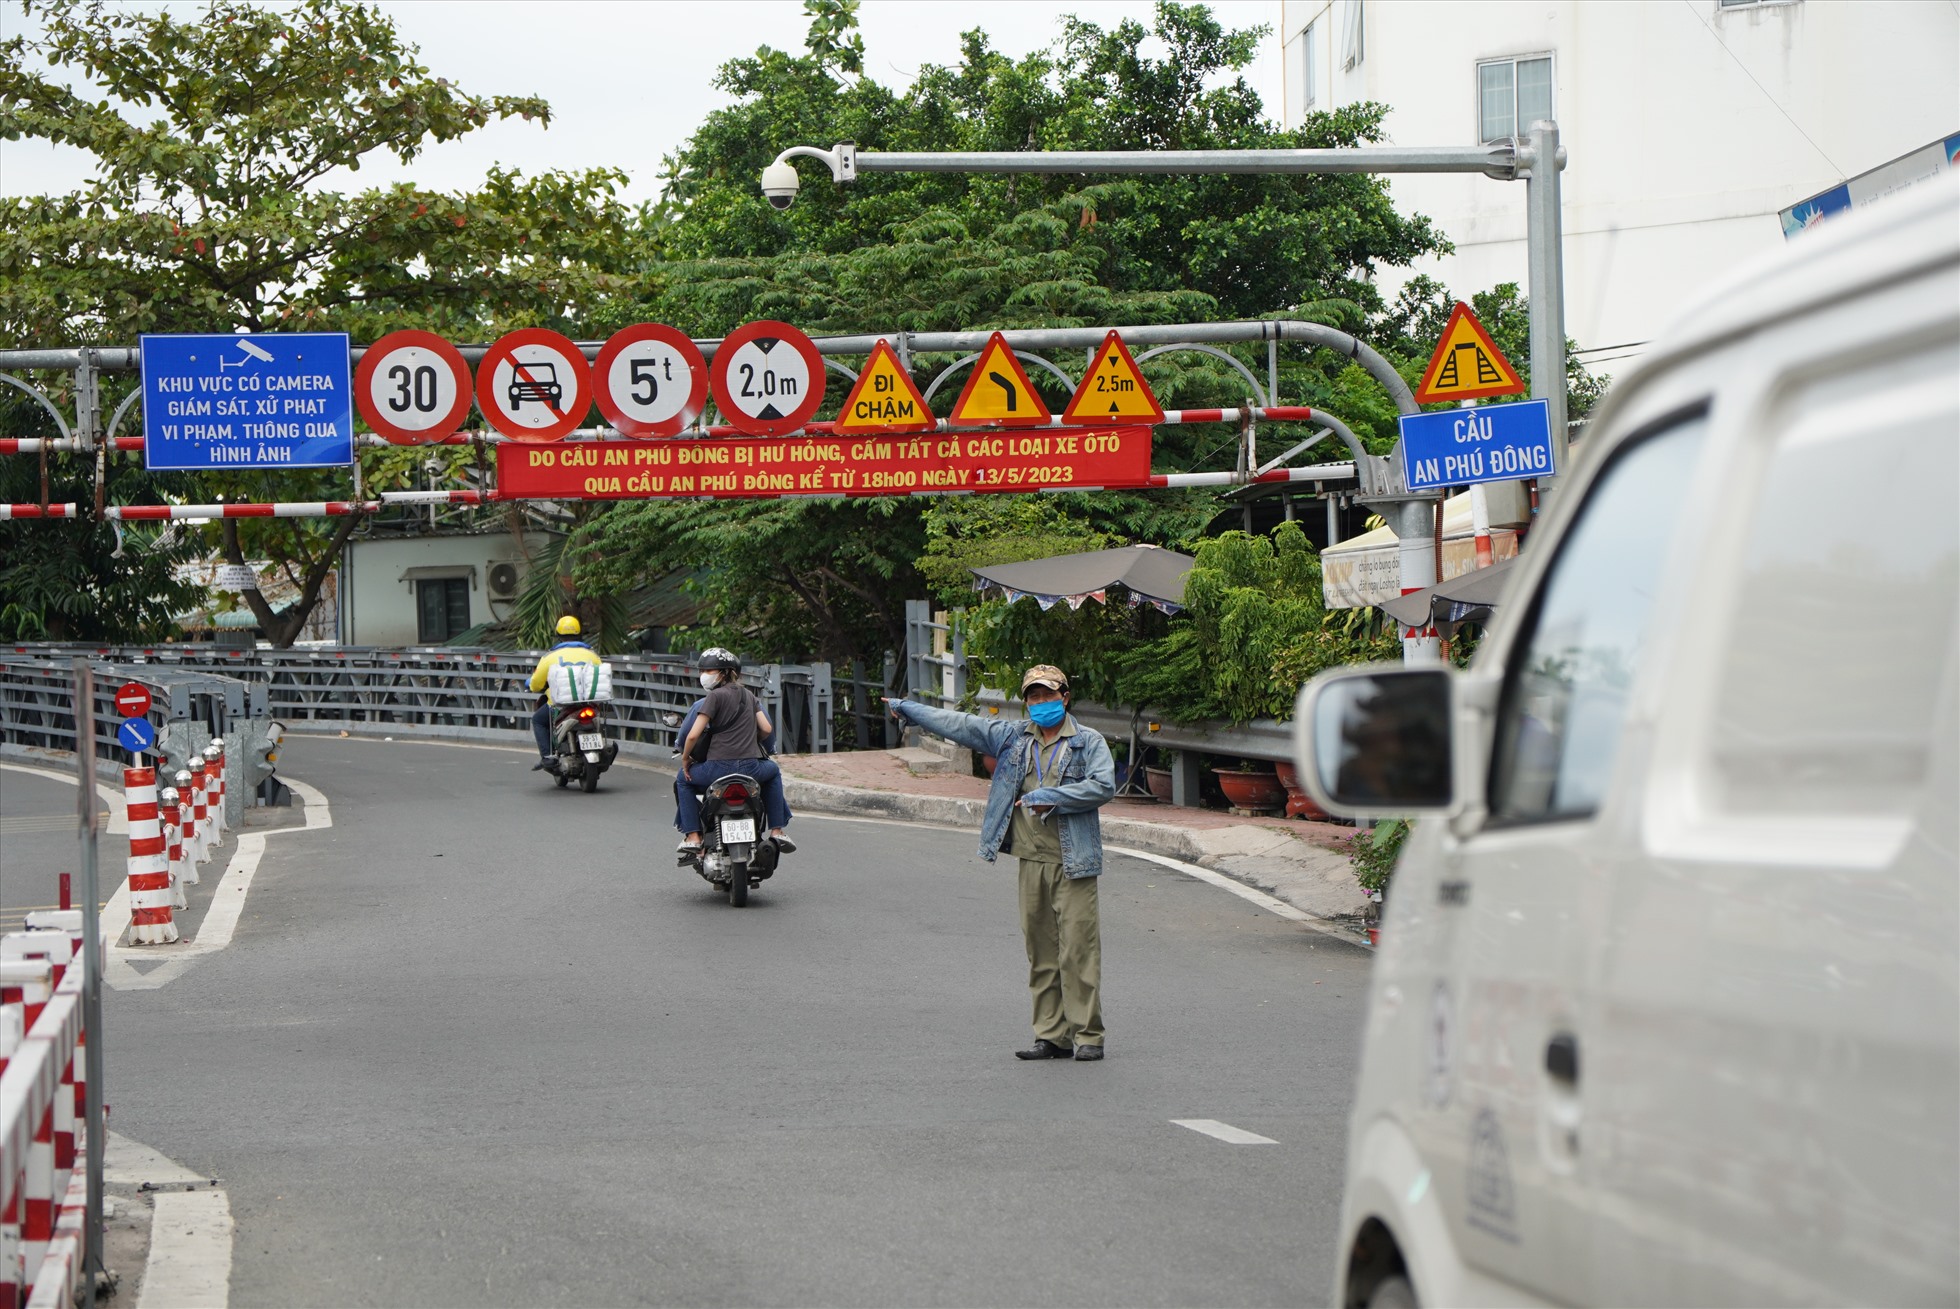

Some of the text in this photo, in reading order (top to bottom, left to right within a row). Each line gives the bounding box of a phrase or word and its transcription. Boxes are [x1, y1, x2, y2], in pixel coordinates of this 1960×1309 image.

[158, 373, 334, 395] KHU VỰC CÓ CAMERA
[388, 364, 437, 413] 30
[873, 374, 894, 393] ĐI
[1096, 374, 1134, 395] 2,5m
[168, 394, 326, 417] GIÁM SÁT, XỬ PHẠT
[855, 396, 914, 423] CHẬM
[161, 420, 337, 443] VI PHẠM, THÔNG QUA
[1454, 411, 1493, 443] CẦU
[210, 442, 291, 462] HÌNH ẢNH
[529, 431, 1120, 467] DO CẦU AN PHÚ ĐÔNG BỊ HƯ HỎNG, CẤM TẤT CẢ CÁC LOẠI XE ÔTÔ
[1415, 445, 1547, 484] AN PHÚ ĐÔNG
[584, 465, 1074, 495] QUA CẦU AN PHÚ ĐÔNG KỂ TỪ 18h00 NGÀY 13/5/2023
[725, 831, 754, 841] 154.12
